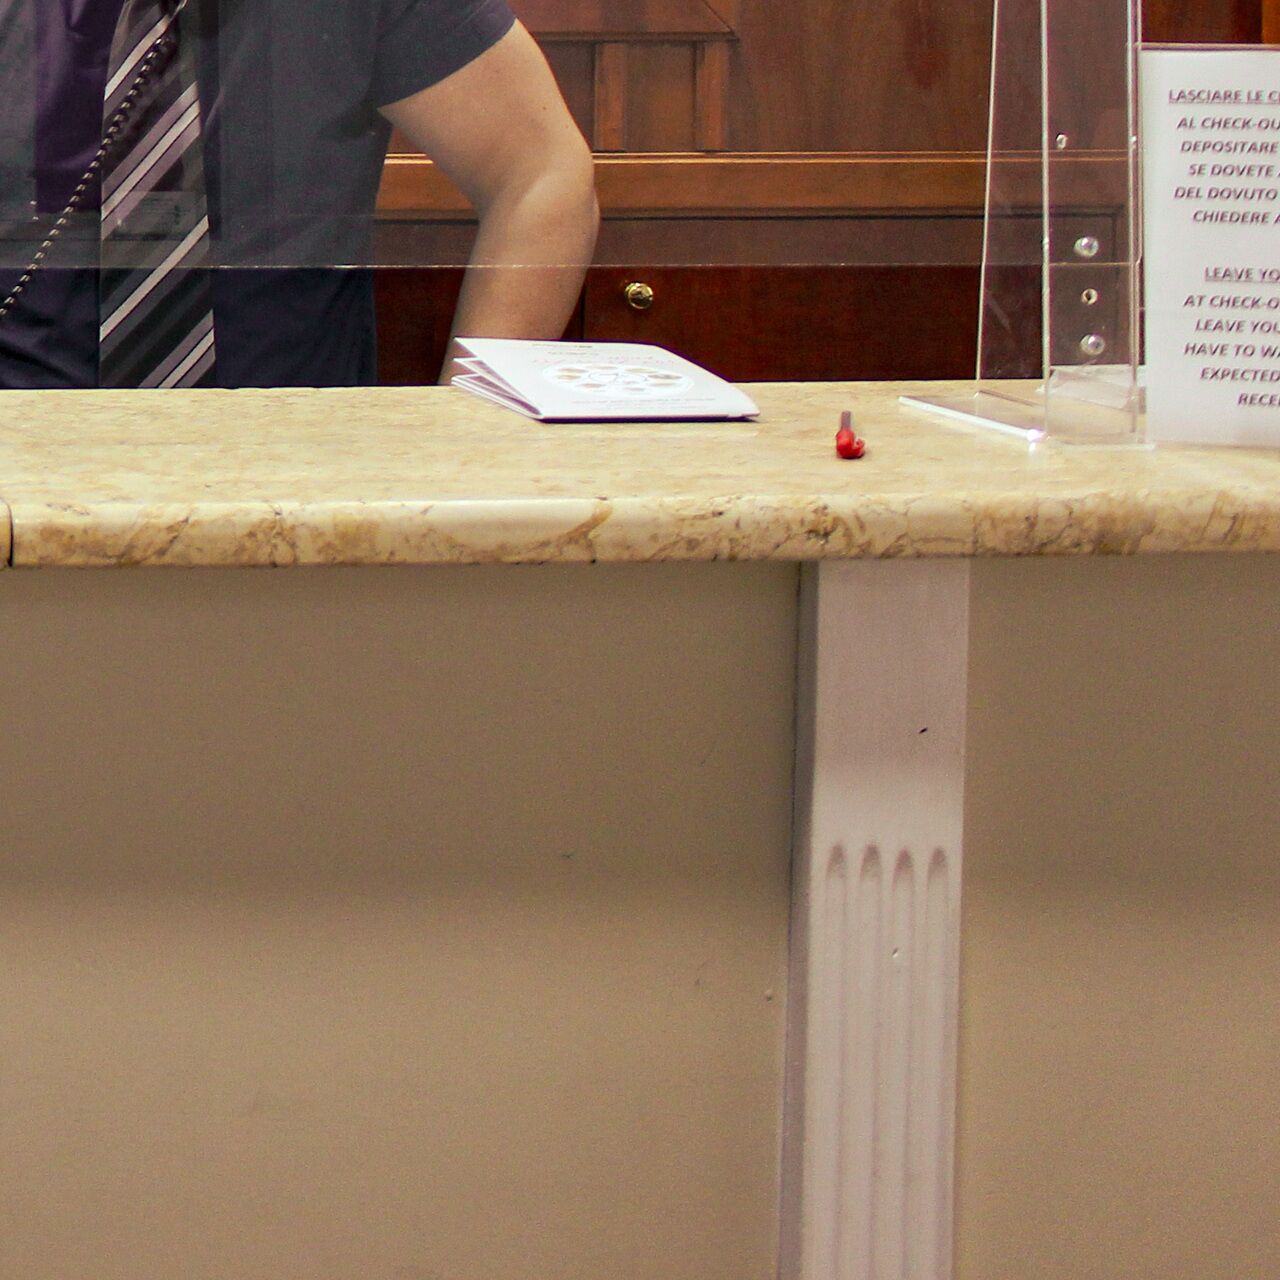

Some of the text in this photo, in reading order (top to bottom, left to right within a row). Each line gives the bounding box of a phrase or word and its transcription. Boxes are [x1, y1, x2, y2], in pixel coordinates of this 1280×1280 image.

[1169, 90, 1243, 103] LASCIARE
[1247, 90, 1264, 103] LE
[1177, 117, 1197, 129] AL
[1181, 141, 1278, 153] DEPOSITARE
[1189, 164, 1274, 177] SE DOVETE
[1174, 186, 1278, 200] DEL DOVUTO
[1193, 210, 1270, 224] CHIEDERE
[1204, 267, 1254, 280] LEAVE
[1184, 295, 1206, 307] AT
[1195, 319, 1245, 332] LEAVE
[1184, 342, 1229, 357] HAVE
[1234, 344, 1256, 357] TO
